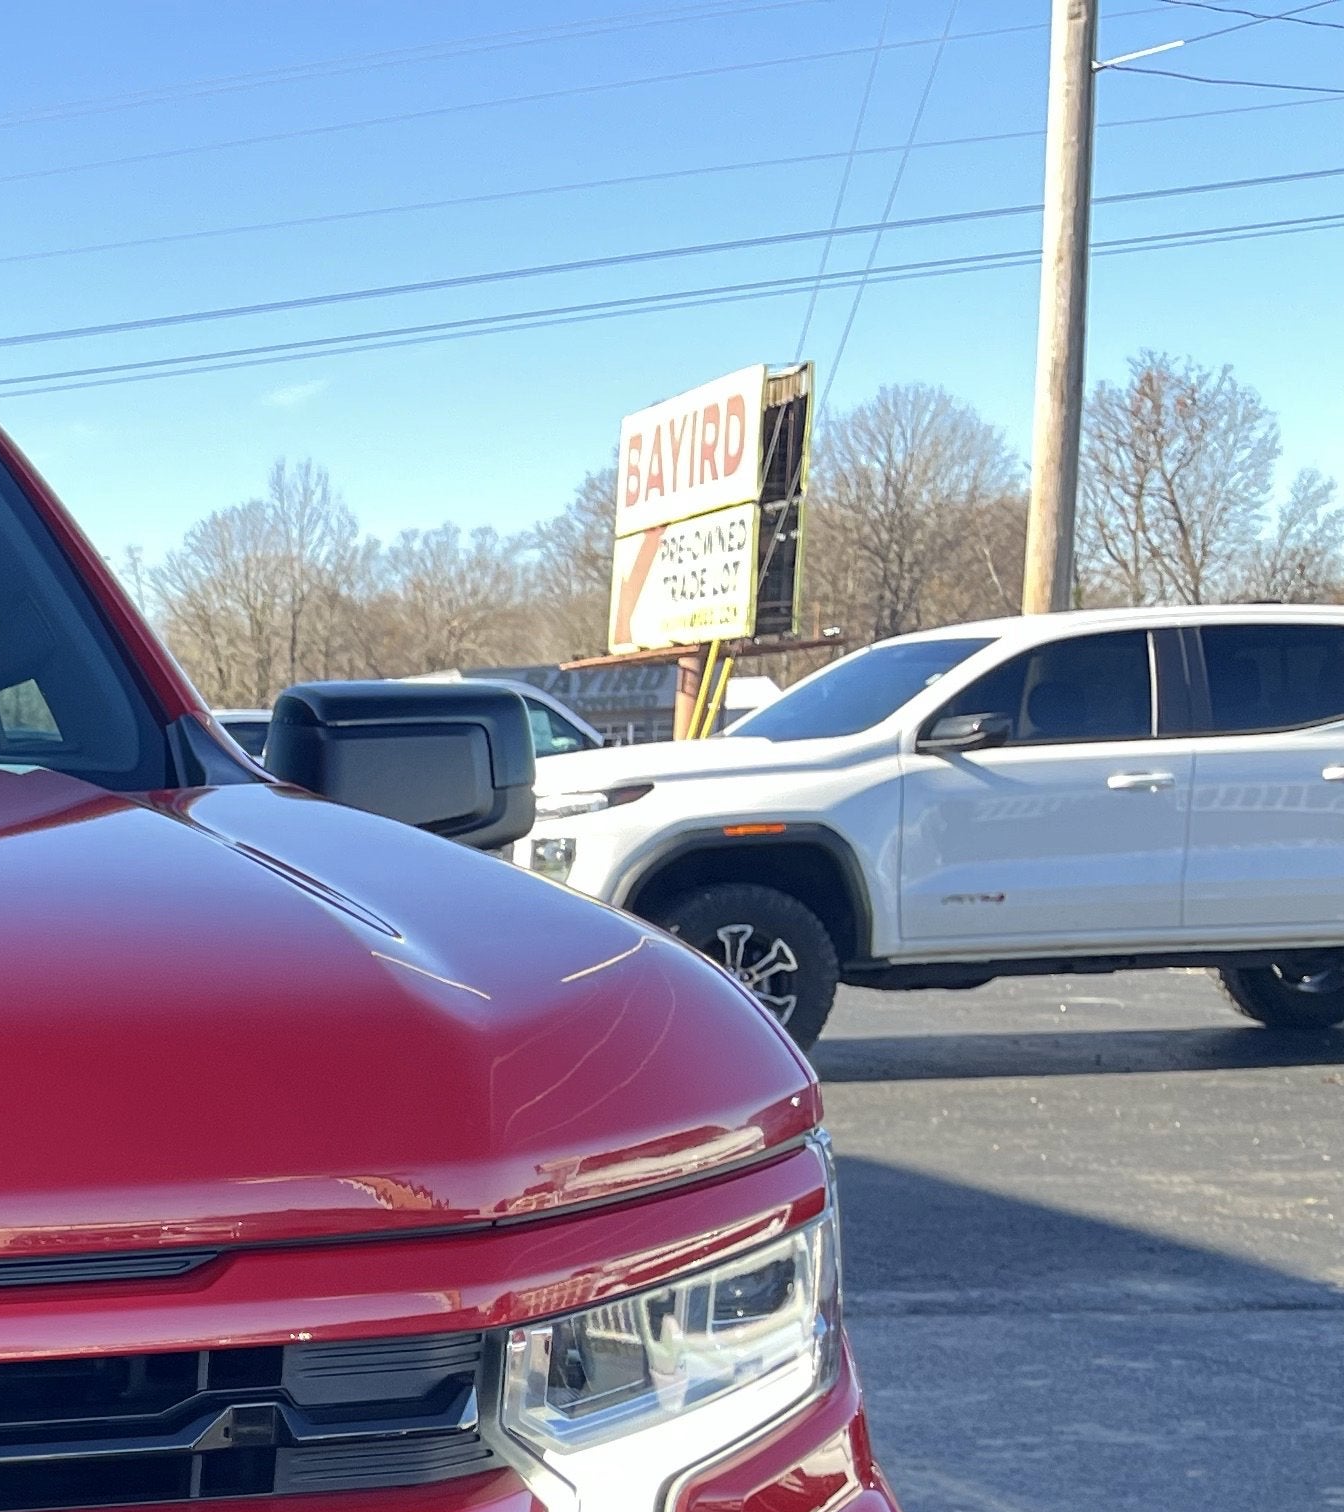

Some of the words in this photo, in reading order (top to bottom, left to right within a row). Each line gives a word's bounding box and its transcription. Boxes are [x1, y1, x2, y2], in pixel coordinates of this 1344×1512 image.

[625, 393, 746, 508] BAYIRD
[660, 518, 747, 565] PRE-OWNED
[663, 567, 707, 602] TRADE
[712, 560, 741, 595] LOT
